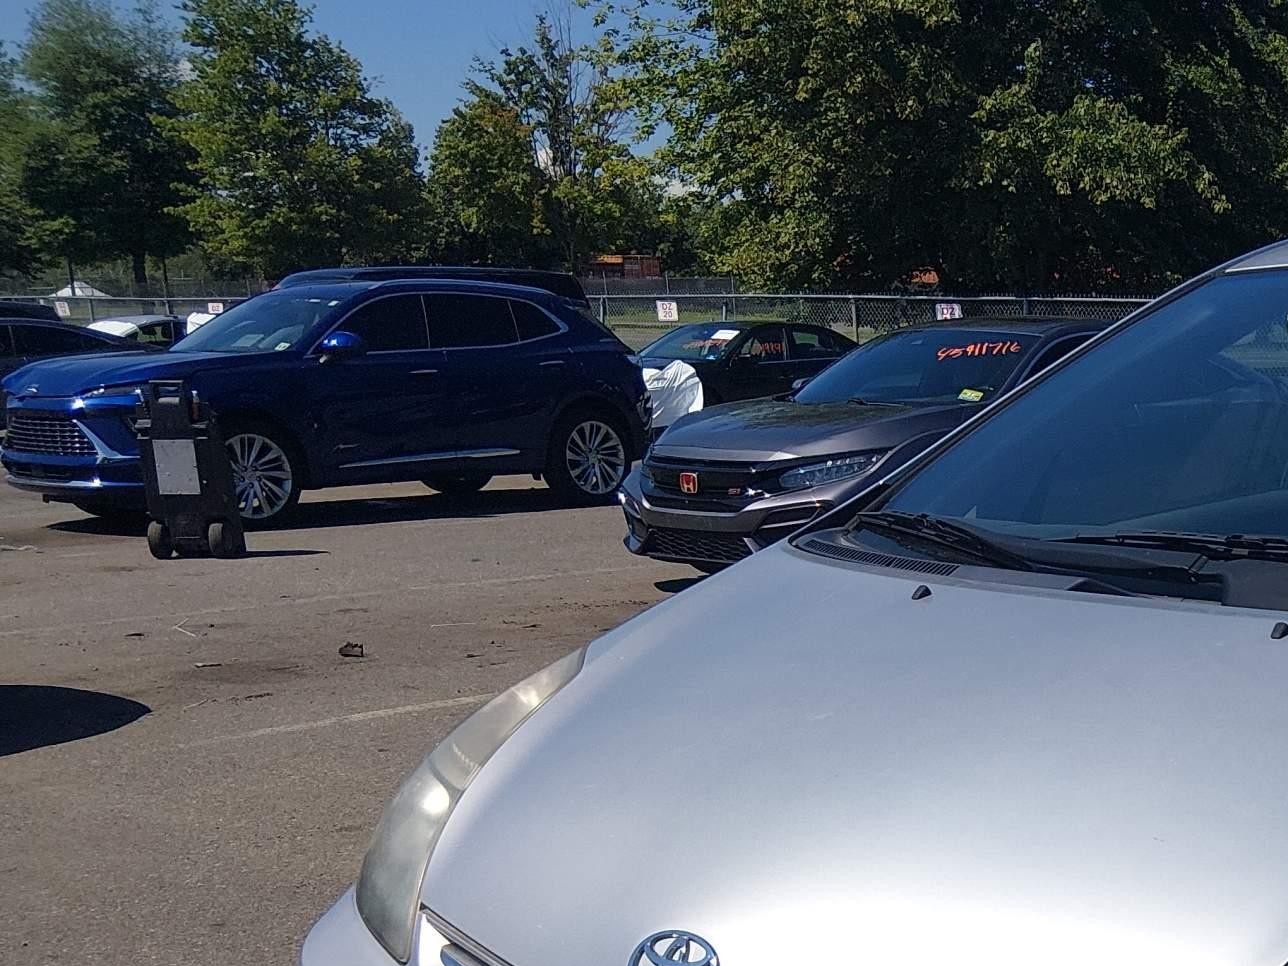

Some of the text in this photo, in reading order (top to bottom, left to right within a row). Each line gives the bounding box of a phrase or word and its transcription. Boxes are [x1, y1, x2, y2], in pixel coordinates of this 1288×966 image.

[663, 310, 673, 318] 20
[942, 307, 955, 315] DZ
[937, 341, 1021, 361] 45911716
